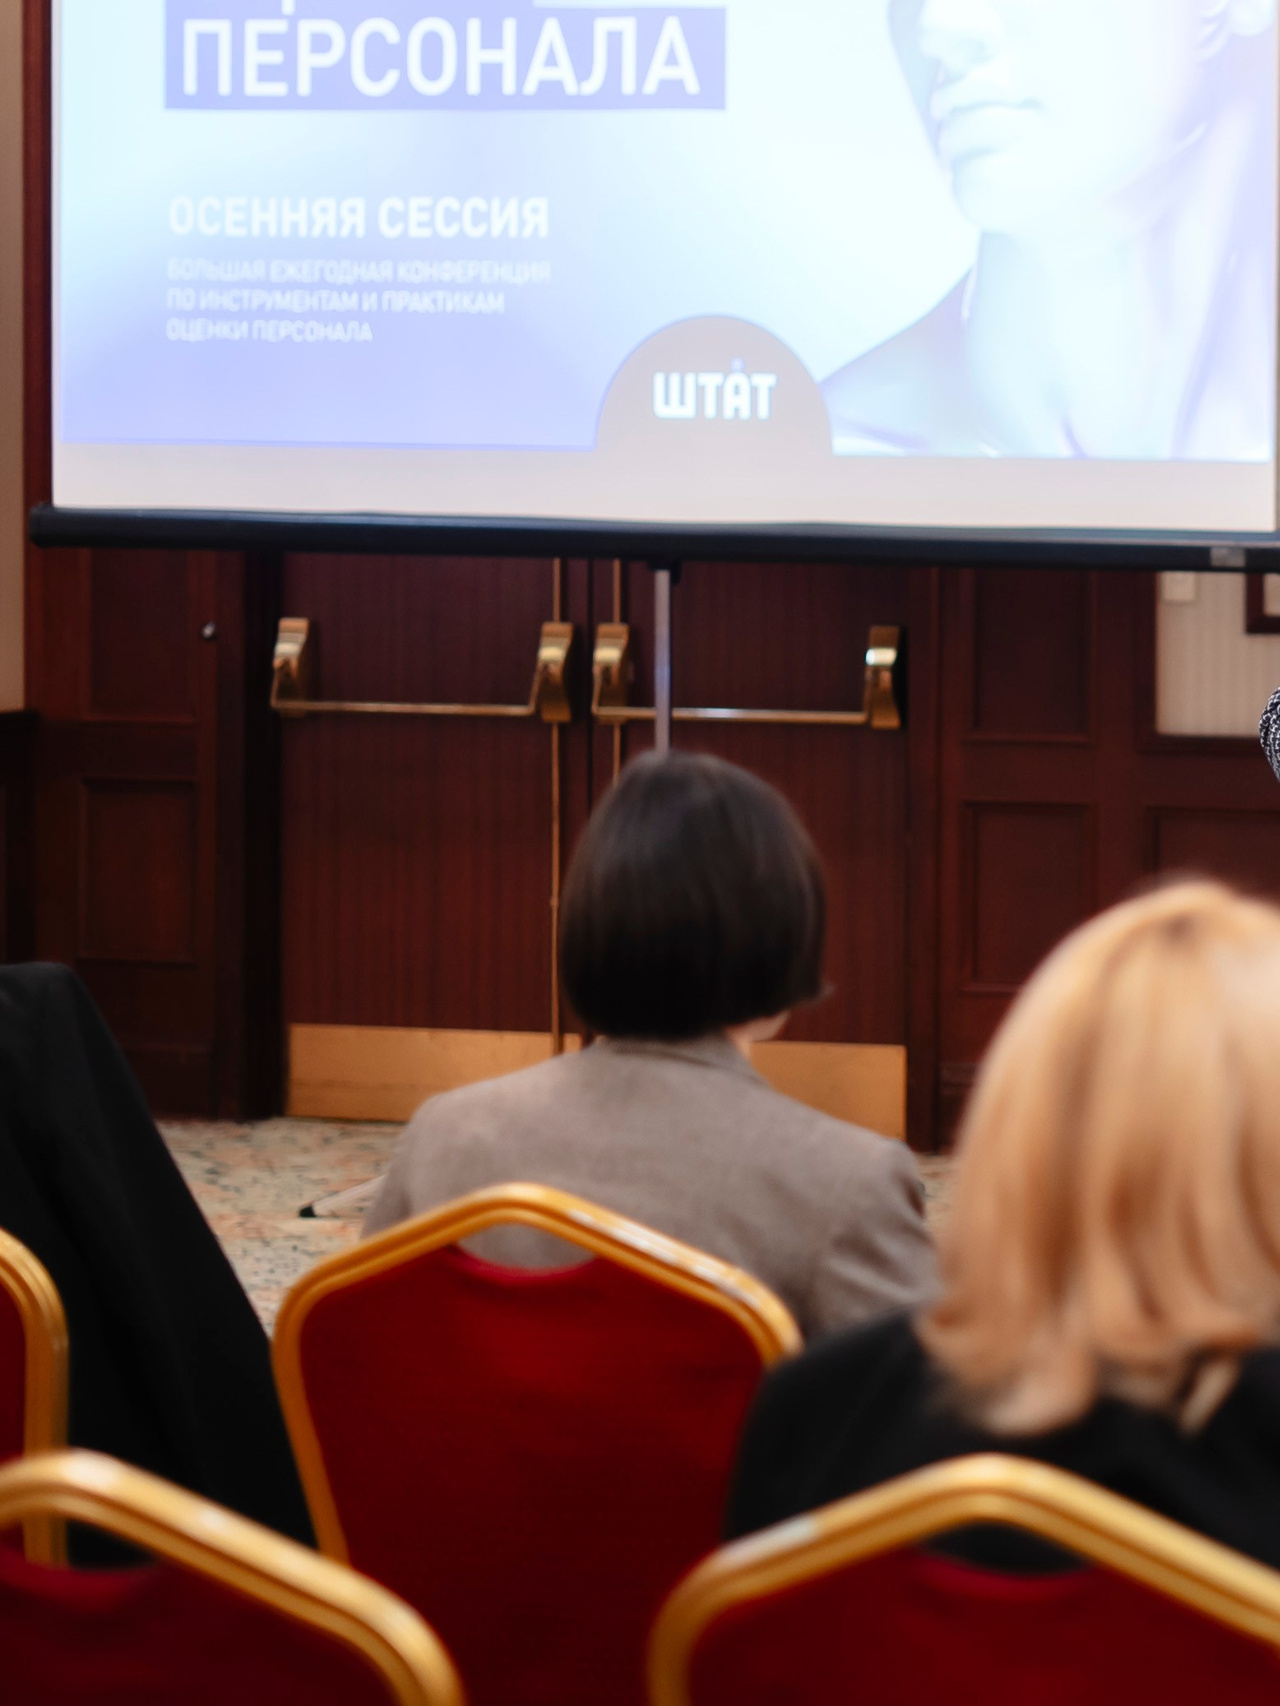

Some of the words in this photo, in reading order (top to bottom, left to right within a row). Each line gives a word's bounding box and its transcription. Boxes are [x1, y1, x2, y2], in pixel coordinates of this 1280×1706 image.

[182, 16, 701, 97] ПЕРСОНАЛА
[169, 196, 366, 238] ОСЕННЯЯ
[377, 196, 549, 239] СЕССИЯ
[166, 258, 265, 282] БОЛЬШАЯ
[269, 259, 393, 284] ЕЖЕГОДНАЯ
[397, 260, 552, 286] КОНФЕРЕНЦИЯ
[166, 289, 196, 311] ПО
[199, 289, 359, 312] ИНСТРУМЕНТАМ
[361, 291, 379, 312] И
[382, 291, 505, 314] ПРАКТИКАМ
[165, 318, 249, 344] ОЦЕНКИ
[252, 319, 373, 342] ПЕРСОНАЛА
